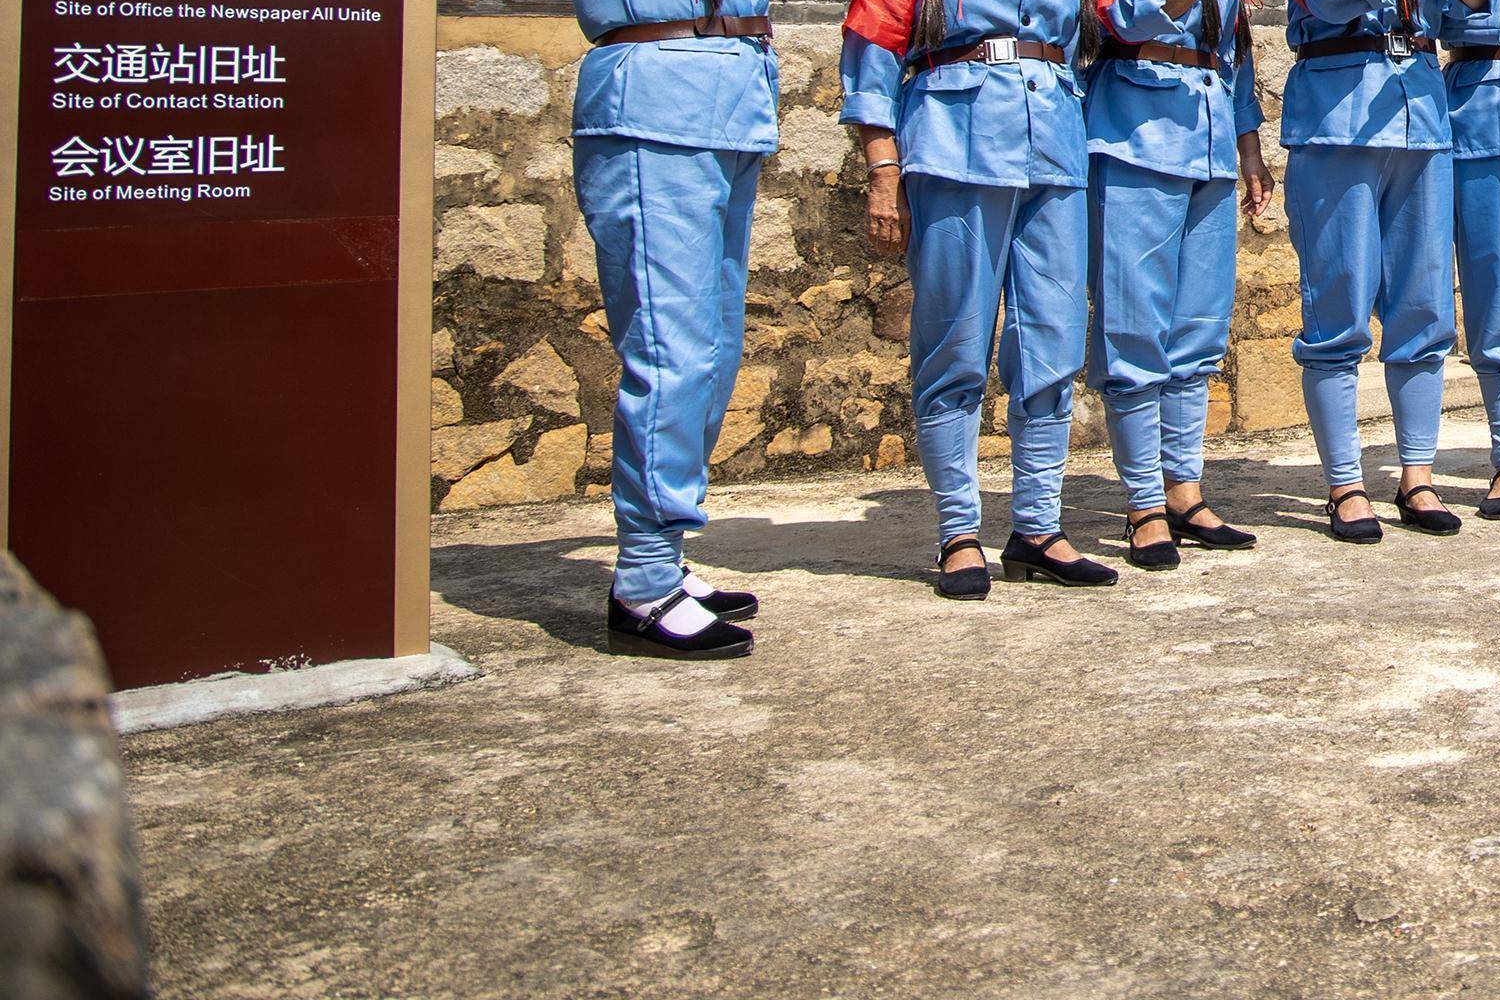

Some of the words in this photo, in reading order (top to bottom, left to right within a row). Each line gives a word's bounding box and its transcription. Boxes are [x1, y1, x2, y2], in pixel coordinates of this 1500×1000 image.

[55, 1, 92, 16] Site
[97, 1, 117, 16] of
[119, 2, 173, 18] Office
[178, 3, 206, 18] the
[211, 4, 309, 23] Newspaper
[312, 6, 333, 21] All
[338, 8, 382, 22] Unite
[53, 42, 286, 84] 交通站旧址
[52, 93, 94, 108] Site
[100, 93, 122, 108] of
[126, 93, 208, 108] Contact
[213, 93, 285, 108] Station
[51, 134, 285, 177] 会议室旧址
[49, 187, 87, 201] Site
[92, 186, 112, 200] of
[116, 184, 192, 202] Meeting
[197, 183, 251, 198] Room
